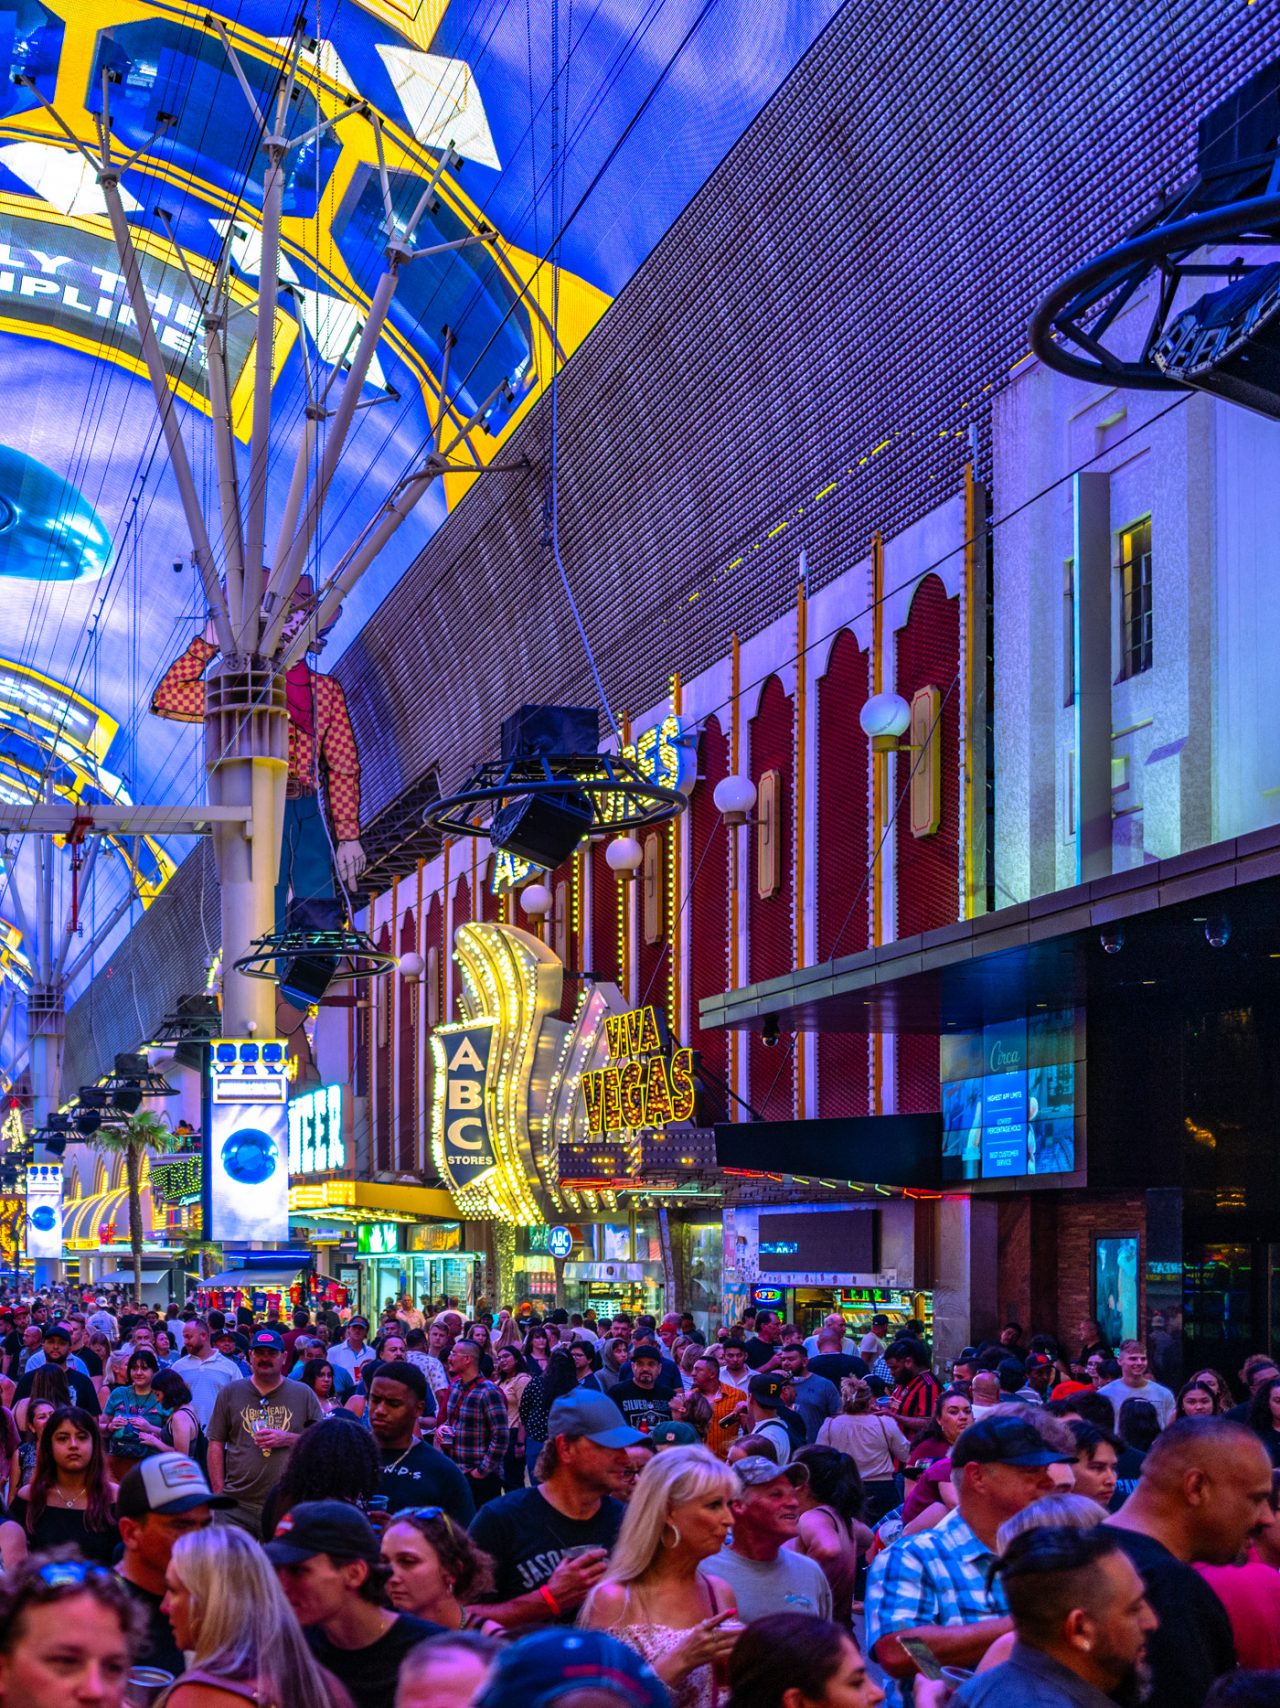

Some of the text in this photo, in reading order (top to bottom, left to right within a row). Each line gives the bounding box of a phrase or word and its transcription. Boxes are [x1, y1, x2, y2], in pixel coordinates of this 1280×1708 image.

[91, 265, 206, 336] THE
[604, 1004, 661, 1060] VIVA
[990, 1040, 1020, 1073] Circa
[447, 1036, 486, 1151] ABC
[580, 1047, 696, 1135] VEGAS
[447, 1155, 493, 1166] STORES
[551, 1231, 569, 1248] ABC
[622, 1399, 648, 1412] SILVER
[770, 1383, 778, 1394] P
[516, 1549, 565, 1589] JASO
